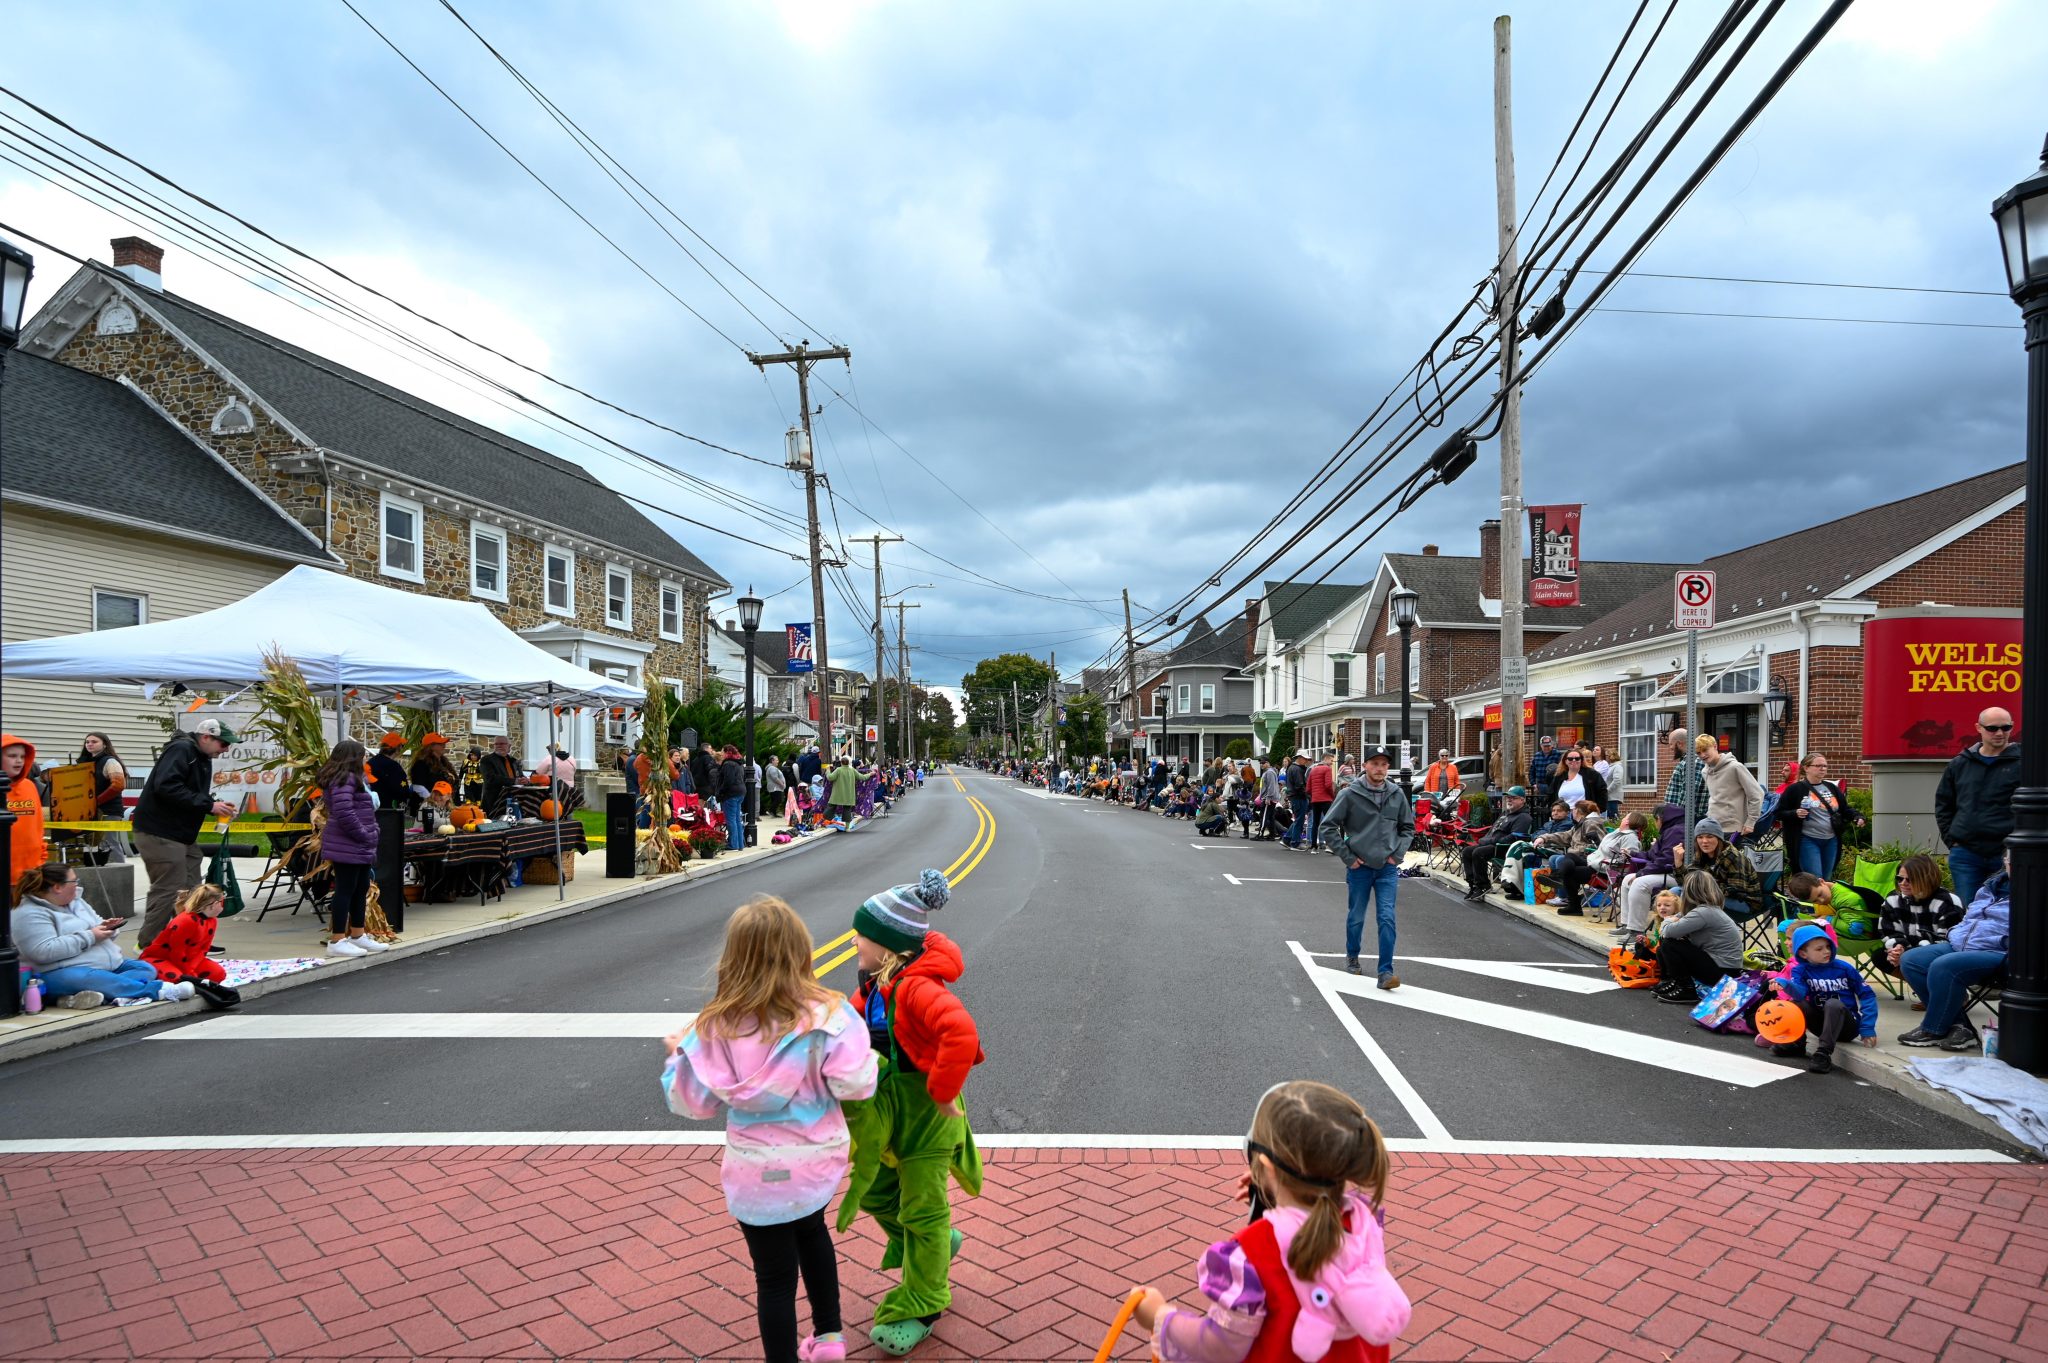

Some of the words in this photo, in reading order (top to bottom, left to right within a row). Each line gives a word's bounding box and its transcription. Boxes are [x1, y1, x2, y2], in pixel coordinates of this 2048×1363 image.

[1533, 518, 1543, 574] Coopersburg
[1535, 591, 1552, 599] Main
[1553, 590, 1573, 598] Street
[1682, 618, 1707, 626] CORNER
[1905, 643, 2023, 666] WELLS
[1908, 669, 2022, 693] FARGO
